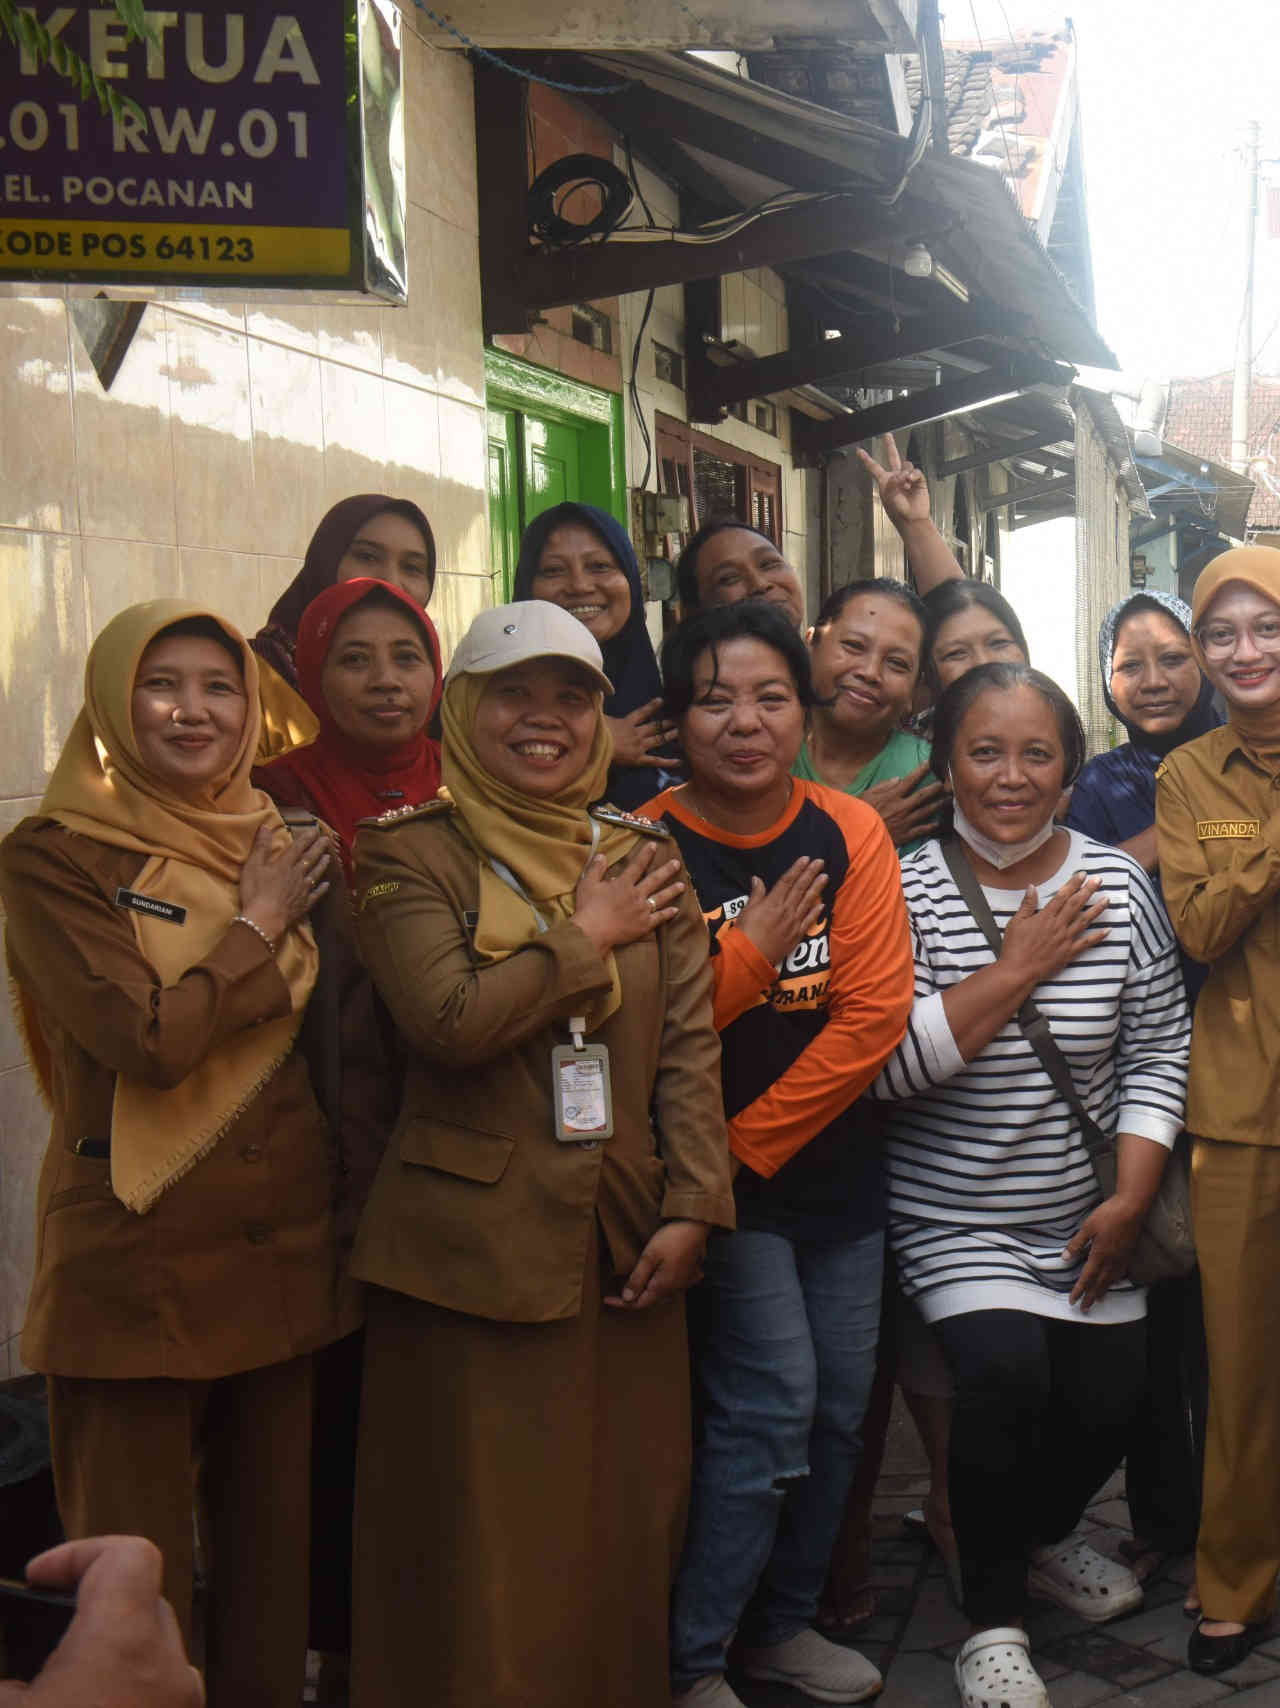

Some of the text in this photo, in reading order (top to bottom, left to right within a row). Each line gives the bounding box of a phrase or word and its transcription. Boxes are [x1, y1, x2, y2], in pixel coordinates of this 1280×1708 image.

[18, 8, 321, 85] KETUA
[113, 104, 309, 159] RW.01
[0, 175, 254, 209] EL. POCANAN
[0, 230, 255, 262] ODE POS 64123
[1200, 822, 1257, 836] VINANDA
